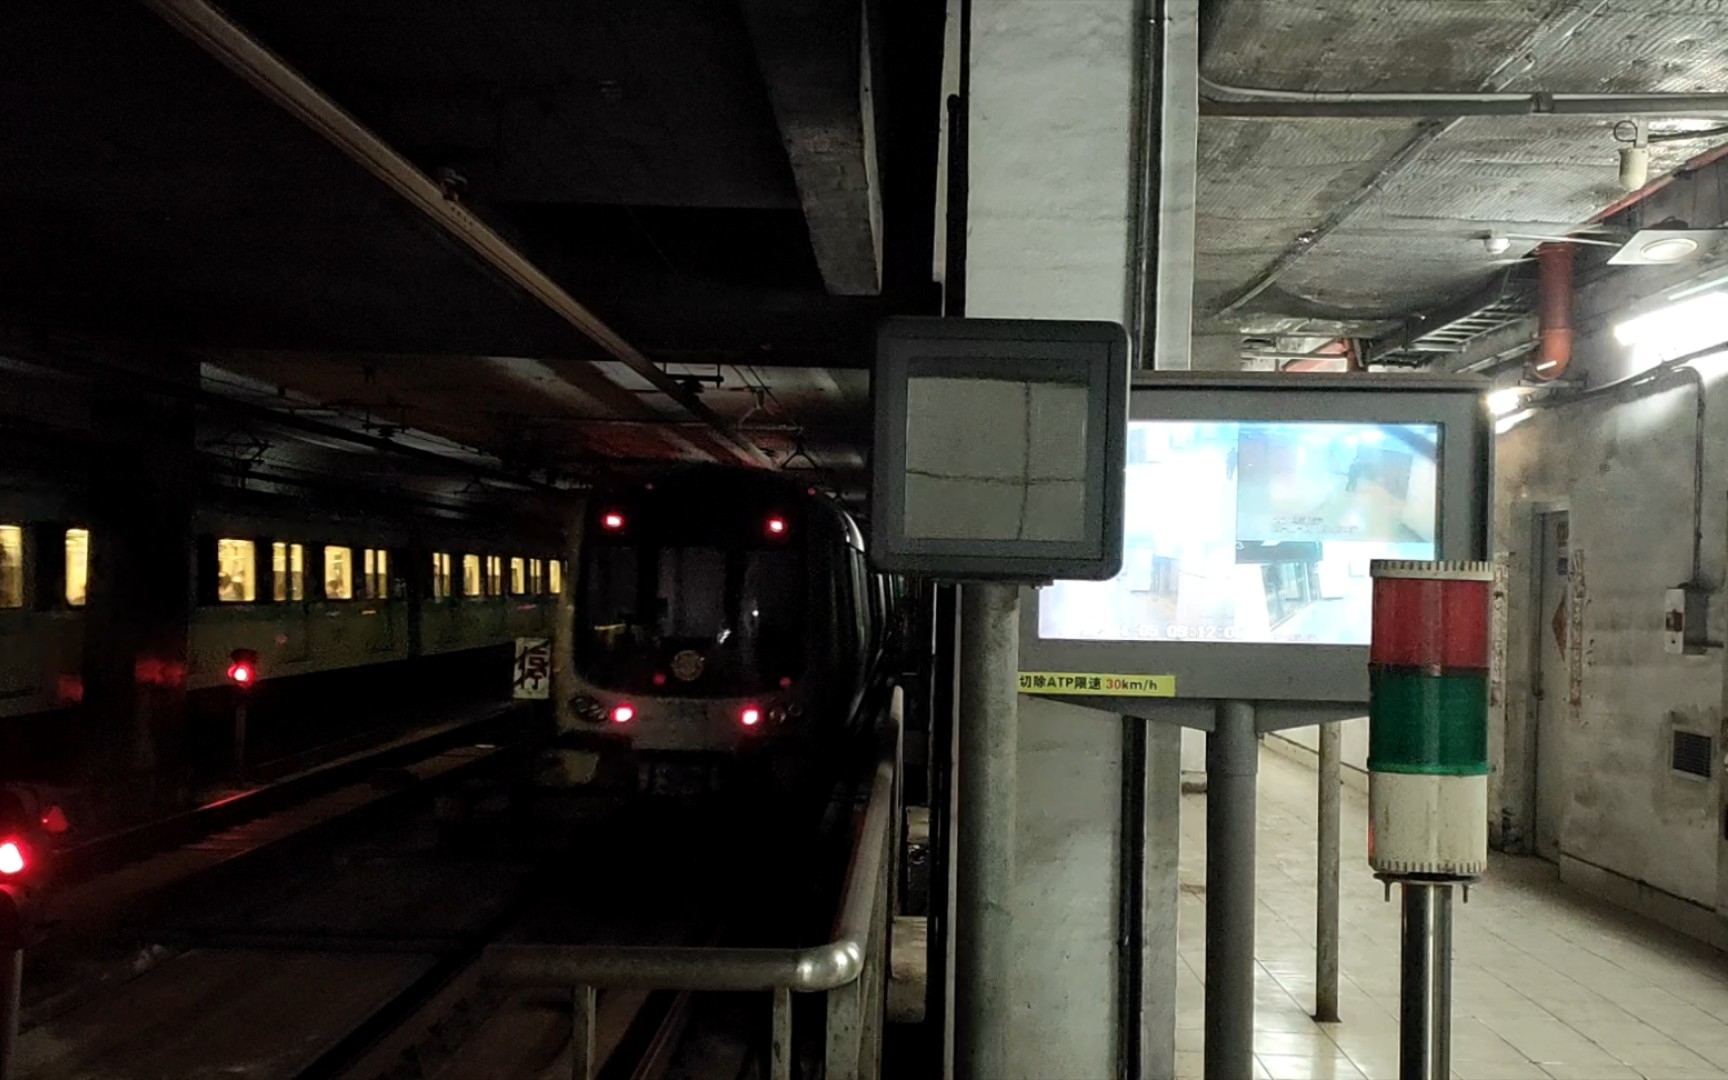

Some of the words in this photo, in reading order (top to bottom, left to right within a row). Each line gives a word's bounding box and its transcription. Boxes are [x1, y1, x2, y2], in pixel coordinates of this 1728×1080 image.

[1019, 674, 1101, 690] 切除ATP限速
[1106, 678, 1158, 691] 30km/h
